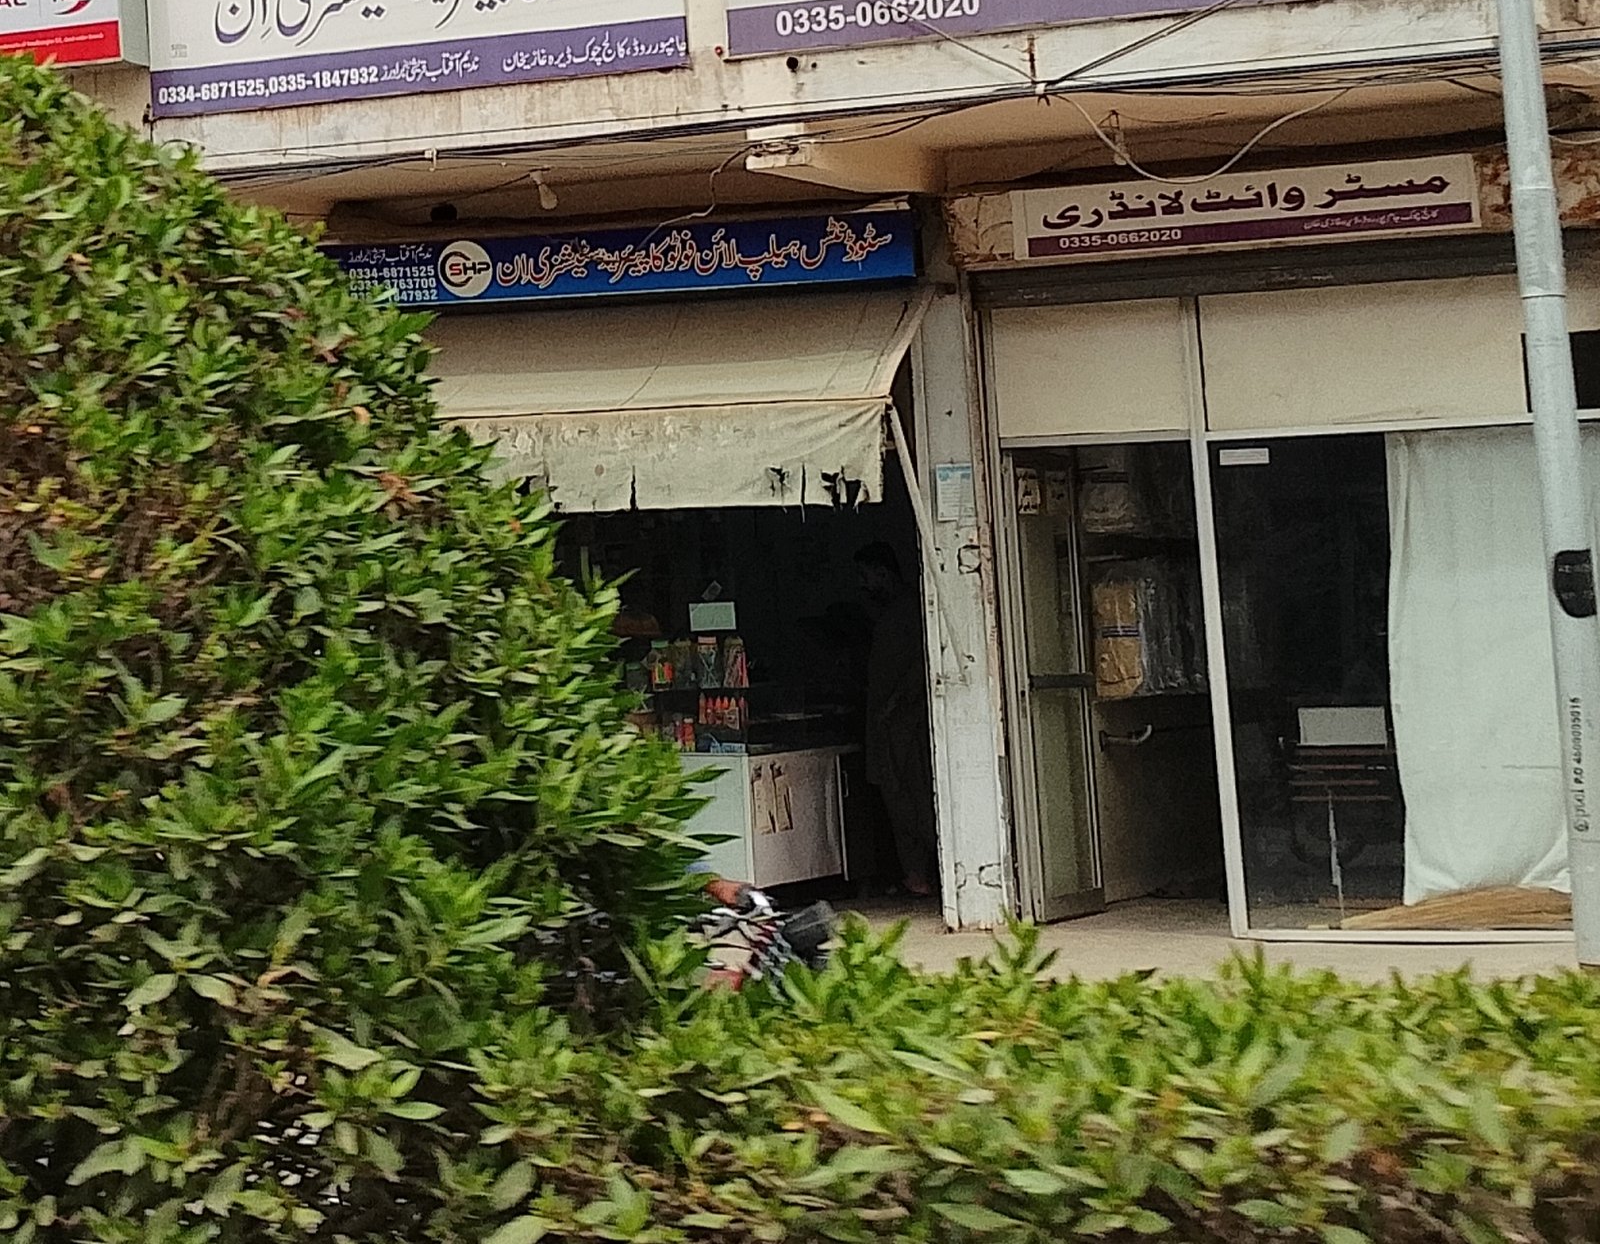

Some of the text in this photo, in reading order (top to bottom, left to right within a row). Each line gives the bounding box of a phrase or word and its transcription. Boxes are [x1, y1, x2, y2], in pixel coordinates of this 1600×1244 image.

[1043, 173, 1450, 230] مسٹر وائٹ لانڈری
[664, 230, 696, 271] فوٹو
[694, 228, 737, 275] لائن
[735, 234, 799, 281] ہیلپ
[800, 216, 892, 269] سٹوڈنٹس
[1060, 229, 1182, 248] 0335-0662020
[349, 265, 434, 279] 0334-6871525
[448, 261, 490, 276] SHP
